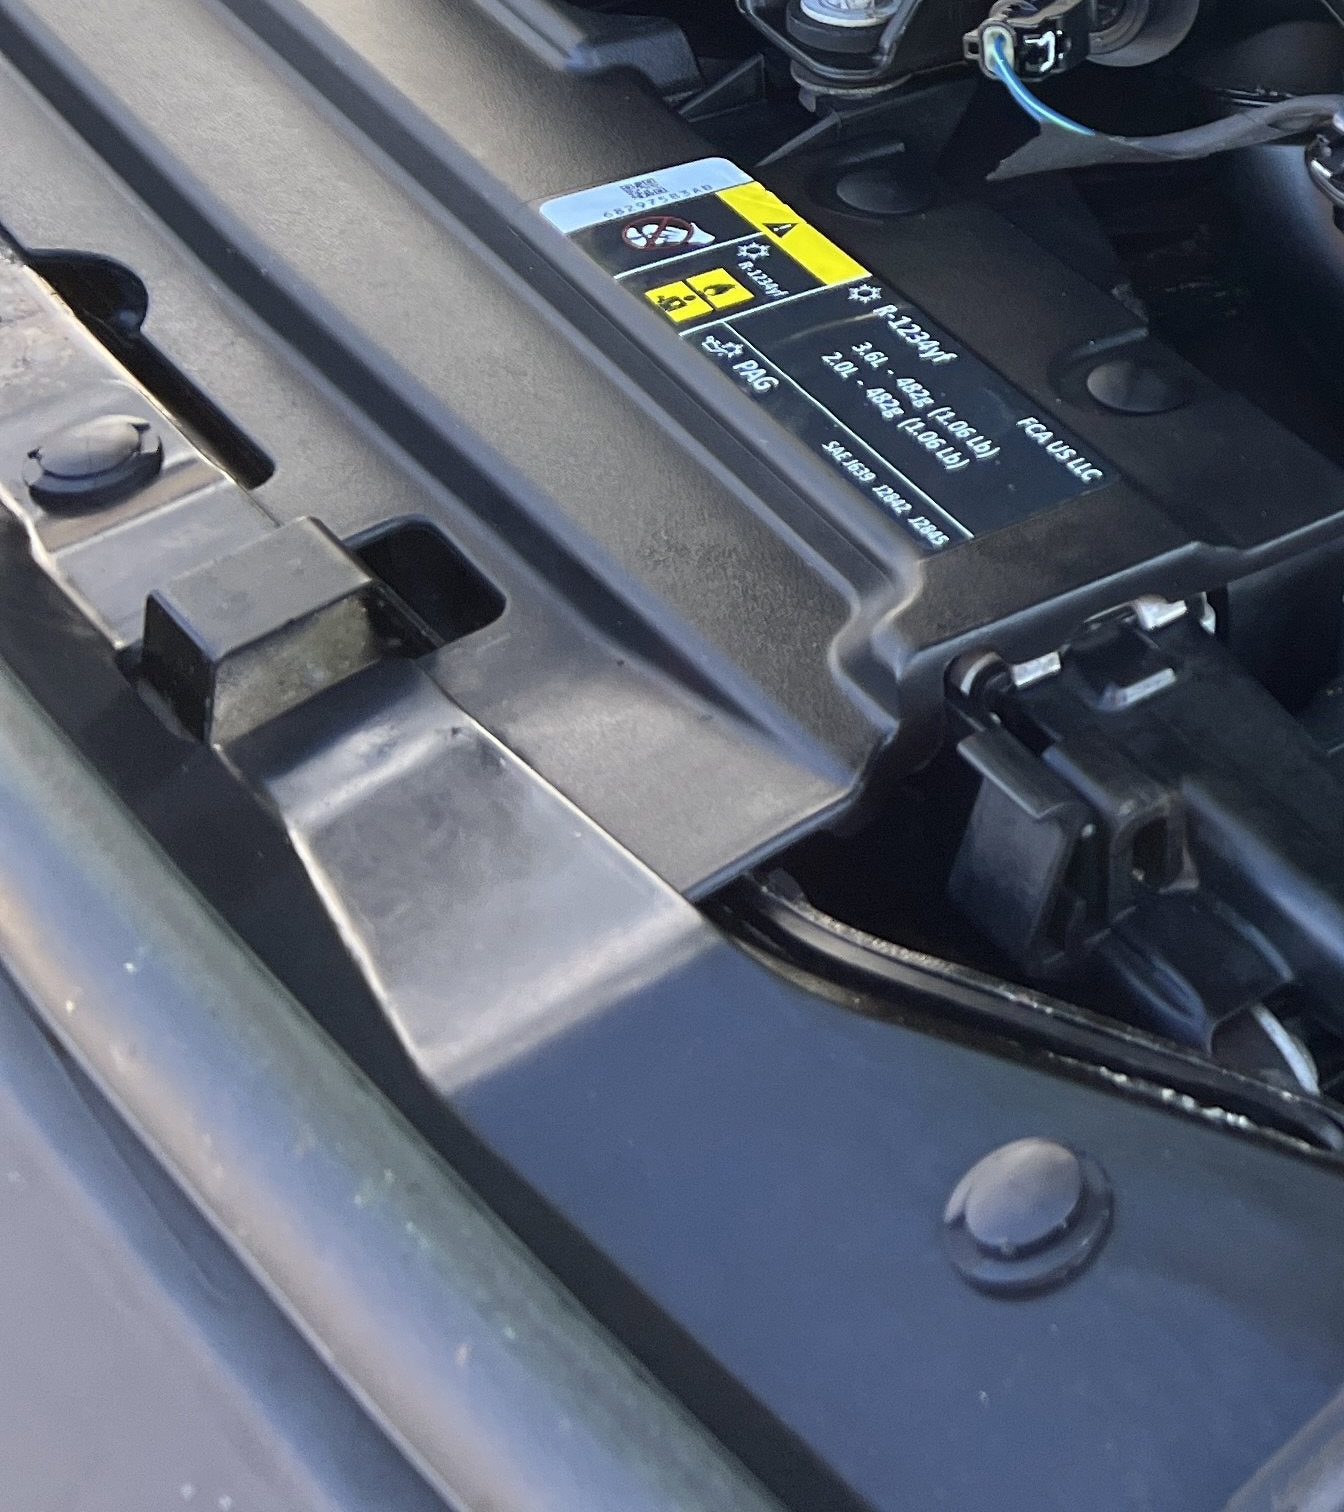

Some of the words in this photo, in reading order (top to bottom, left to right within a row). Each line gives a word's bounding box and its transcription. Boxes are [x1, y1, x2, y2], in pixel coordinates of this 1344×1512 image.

[738, 260, 790, 298] R-1234yf
[872, 303, 958, 365] R-1234yf
[732, 359, 780, 393] PAG
[851, 341, 889, 369] 3.6L
[896, 377, 935, 409] 482g
[927, 406, 977, 439] (1.06
[966, 434, 1001, 459] Lb)
[821, 351, 859, 379] 2.0L
[866, 387, 905, 420] 482g
[897, 417, 947, 450] (1.06
[935, 446, 970, 470] Lb)
[821, 440, 853, 461] SAE
[1016, 416, 1054, 445] FCA
[1046, 440, 1077, 463] US
[1066, 457, 1104, 484] LLC
